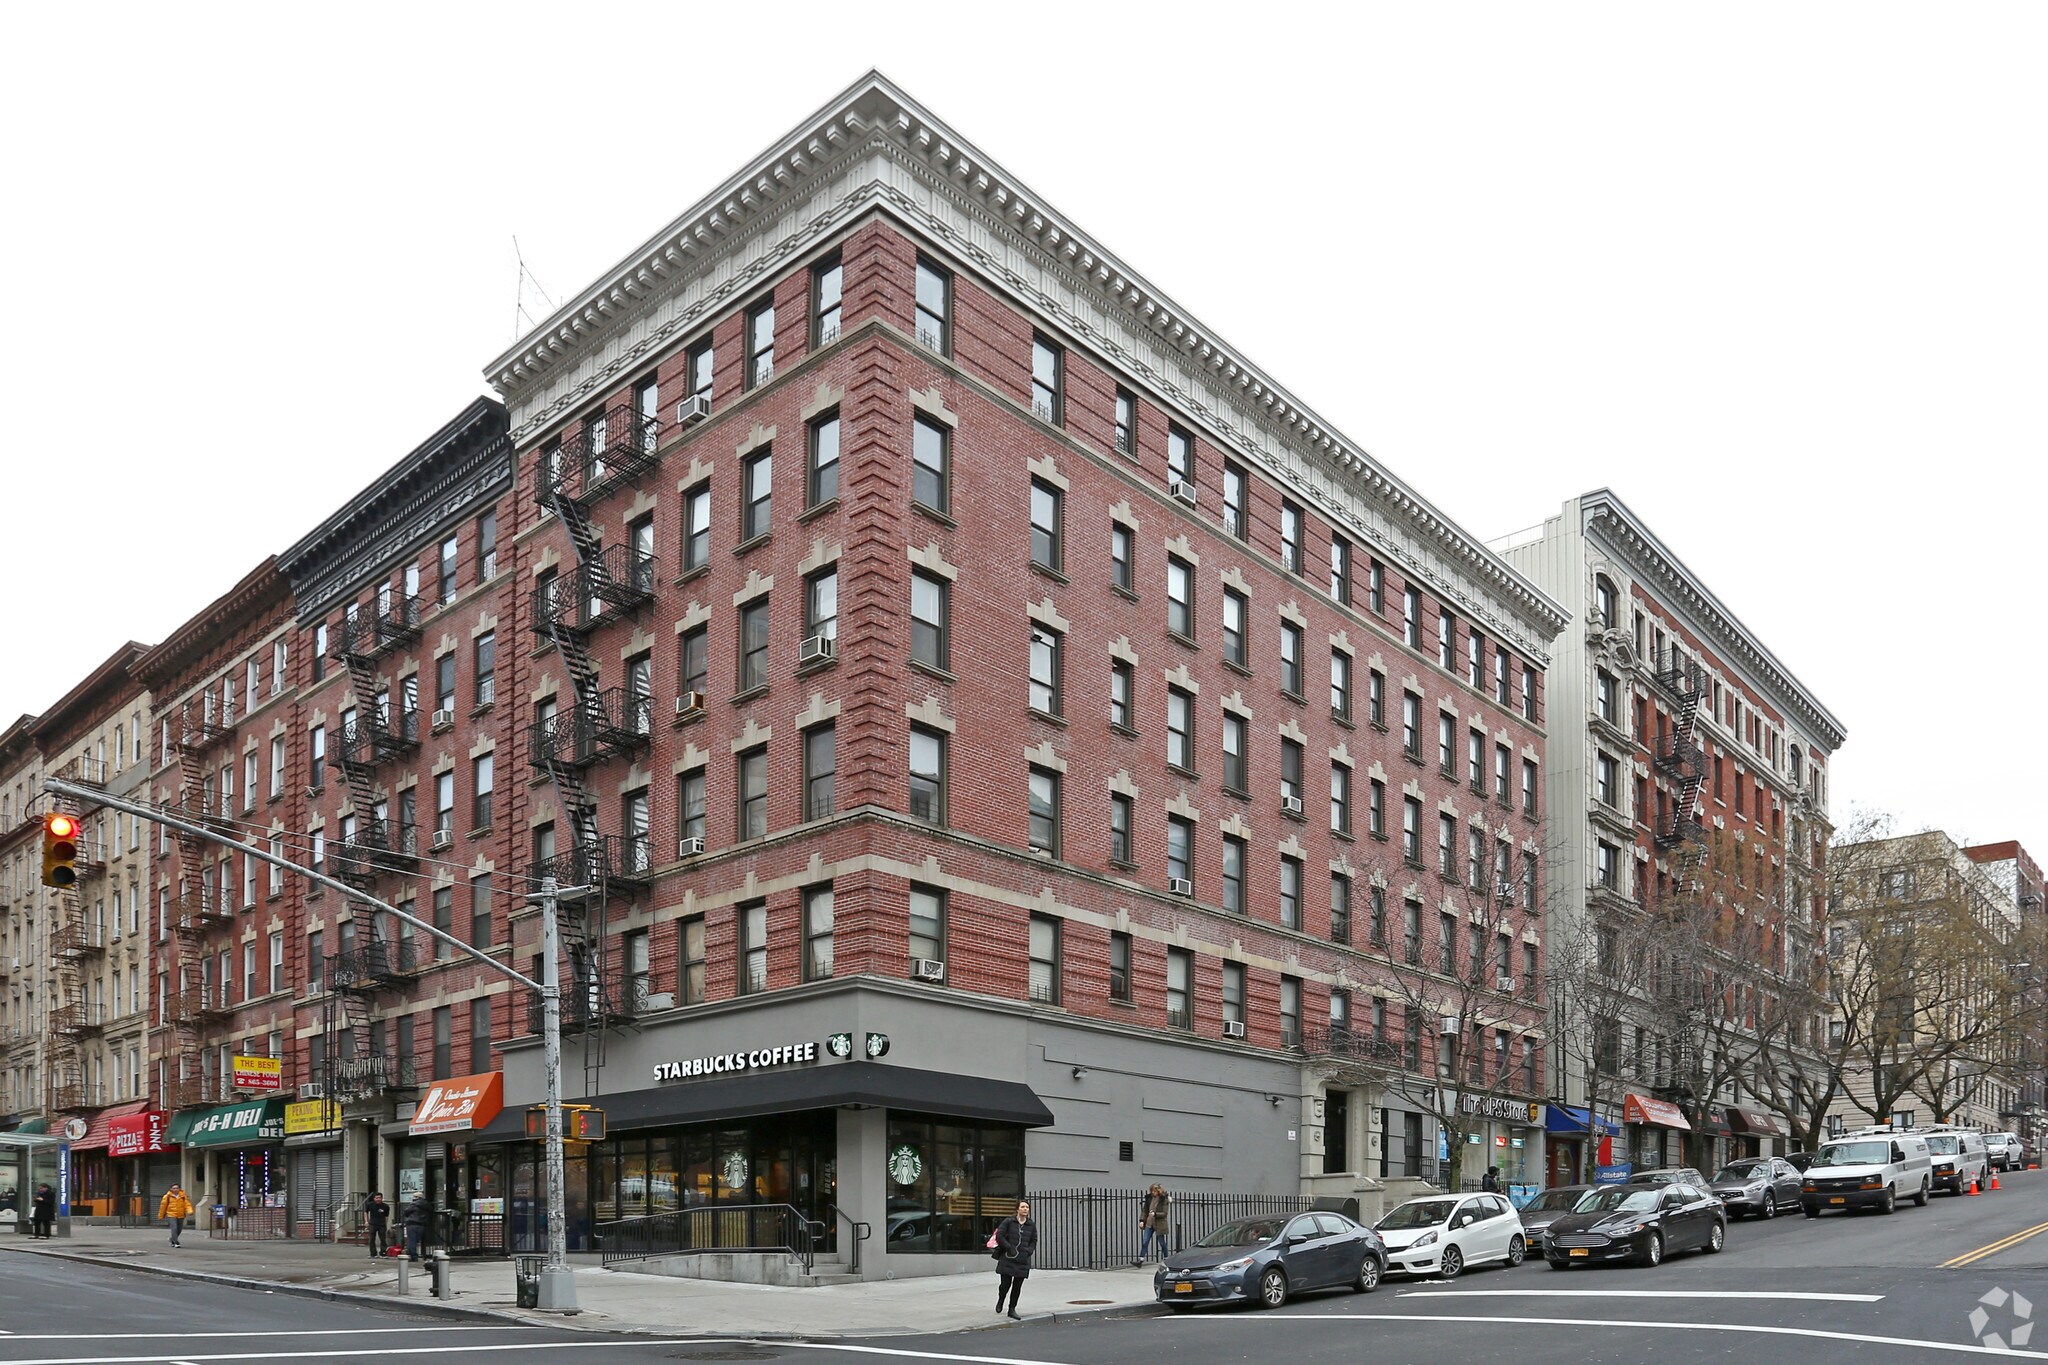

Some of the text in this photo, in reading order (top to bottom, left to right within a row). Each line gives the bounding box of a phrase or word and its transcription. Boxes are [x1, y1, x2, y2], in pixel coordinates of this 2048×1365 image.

[240, 1059, 275, 1069] THE BEST
[653, 1042, 815, 1081] STARBUCKS COFFEE
[453, 1099, 475, 1117] Bar
[1462, 1093, 1482, 1114] The
[1482, 1097, 1504, 1118] UPS
[1503, 1100, 1528, 1121] Store
[207, 1112, 233, 1132] G-H
[232, 1107, 262, 1128] DELI
[116, 1132, 137, 1148] PIZZA
[148, 1115, 162, 1150] PIZZA
[258, 1127, 285, 1138] DEL
[824, 1163, 832, 1195] BREAKS
[1600, 1171, 1627, 1179] Allstate
